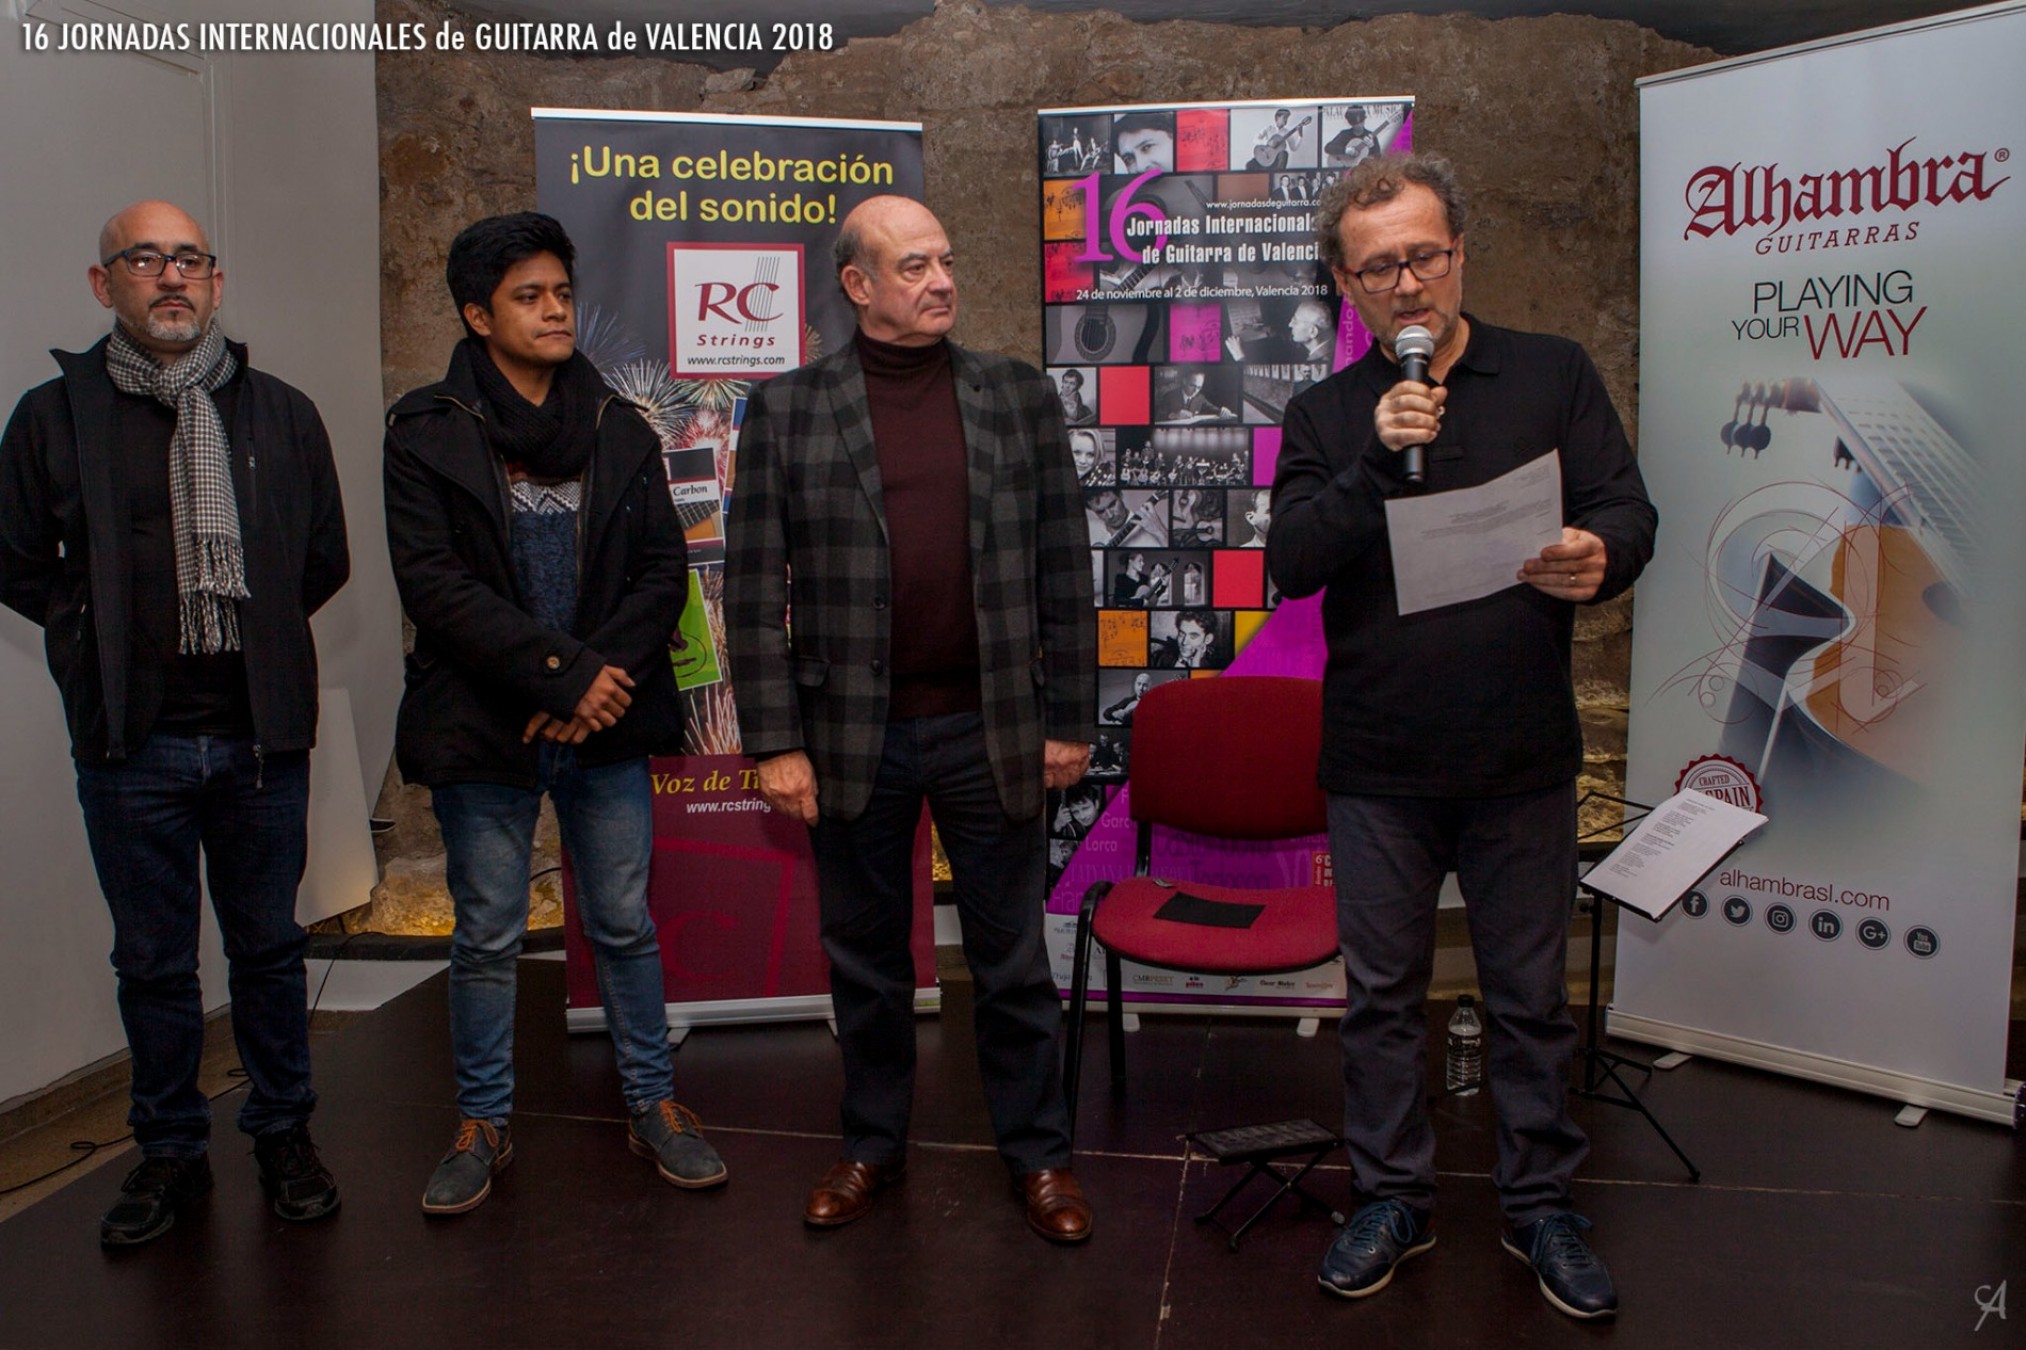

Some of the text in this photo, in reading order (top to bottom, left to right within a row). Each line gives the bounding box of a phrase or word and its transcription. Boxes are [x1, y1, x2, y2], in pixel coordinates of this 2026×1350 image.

[570, 145, 894, 184] ¡Una celebración
[1684, 136, 2011, 241] Alhambra
[629, 190, 836, 224] del sonido!
[1070, 167, 1169, 263] 16
[1126, 216, 1200, 237] Jornadas
[1754, 222, 1920, 255] GUITARRAS
[1142, 245, 1160, 264] de
[1166, 244, 1232, 264] Guitarra
[1238, 242, 1256, 263] de
[695, 281, 784, 326] RC
[1076, 284, 1328, 300] 24 de noviembre al 2 de diciembre, Valencia 2018
[1753, 269, 1914, 314] PLAYING
[696, 333, 776, 348] Strings
[1731, 306, 1928, 361] YOUR WAY
[687, 354, 785, 368] www.rcstrings.com
[673, 484, 708, 498] Carbon
[650, 773, 696, 795] Voz
[702, 769, 732, 792] de
[1698, 773, 1731, 787] CRAFTED
[1719, 868, 1891, 912] alhambrasl.com
